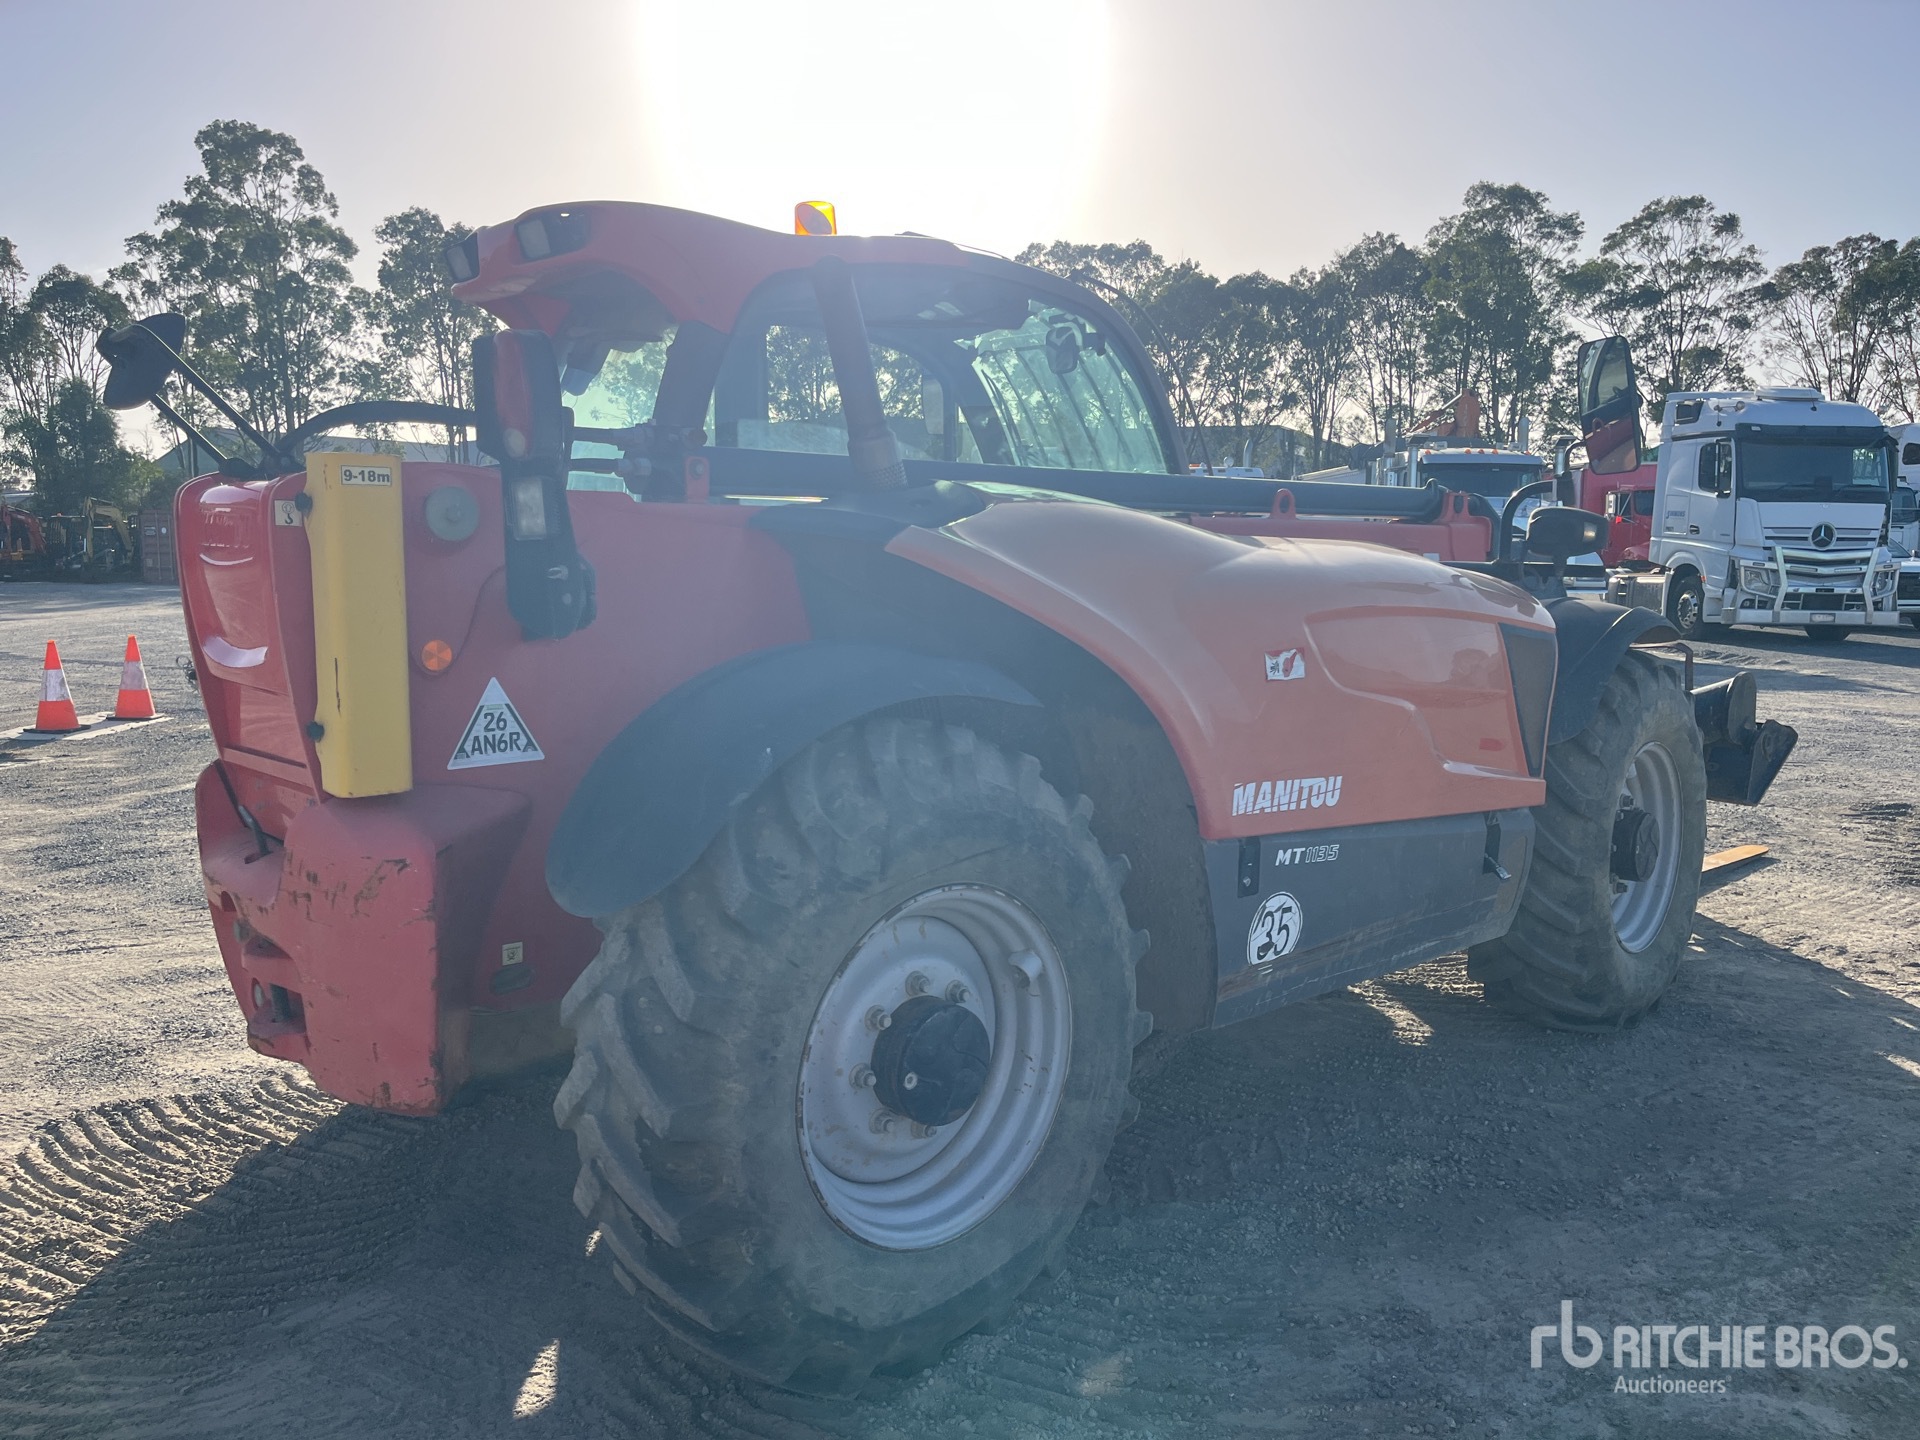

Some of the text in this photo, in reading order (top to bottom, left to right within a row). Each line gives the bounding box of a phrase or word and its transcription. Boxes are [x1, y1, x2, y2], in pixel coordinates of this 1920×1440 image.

[343, 469, 390, 482] 9-18m
[483, 711, 508, 732] 26
[470, 731, 522, 756] AN6R
[1231, 776, 1343, 816] MANITOU
